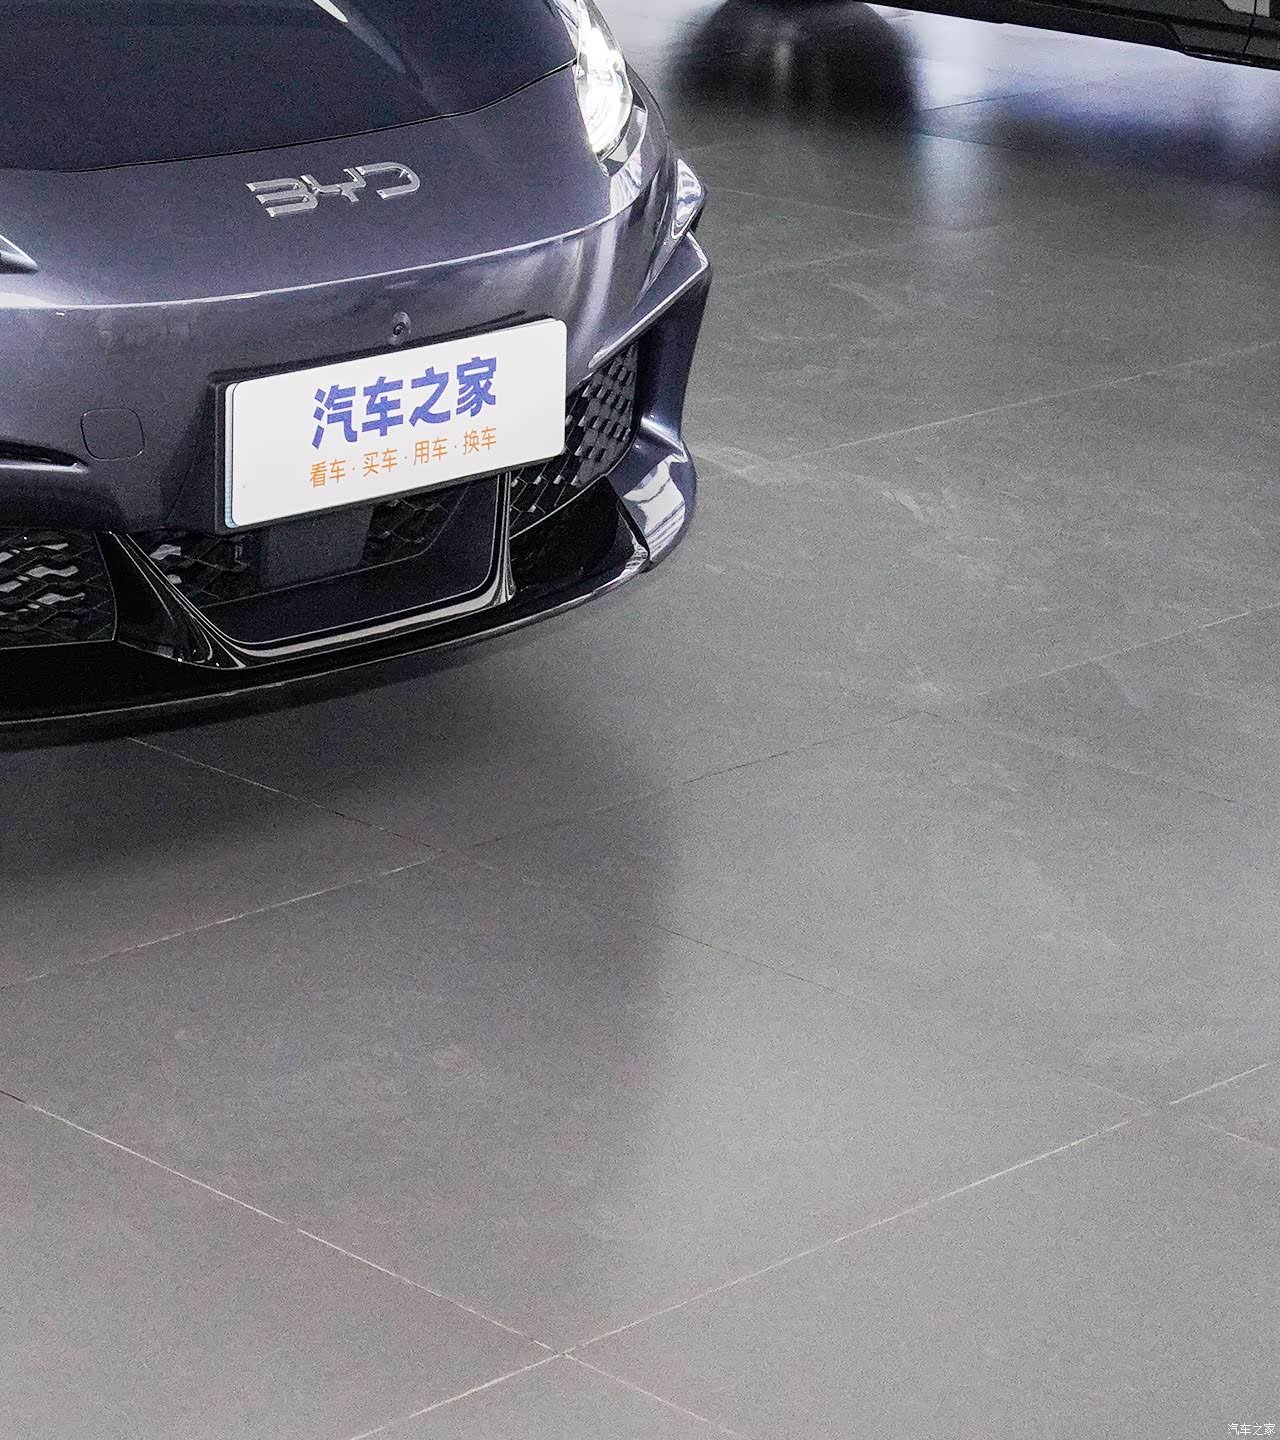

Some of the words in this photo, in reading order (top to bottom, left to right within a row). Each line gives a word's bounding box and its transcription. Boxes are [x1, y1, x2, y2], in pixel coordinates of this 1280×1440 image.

[245, 161, 421, 219] BYD
[311, 355, 498, 450] 汽车之家
